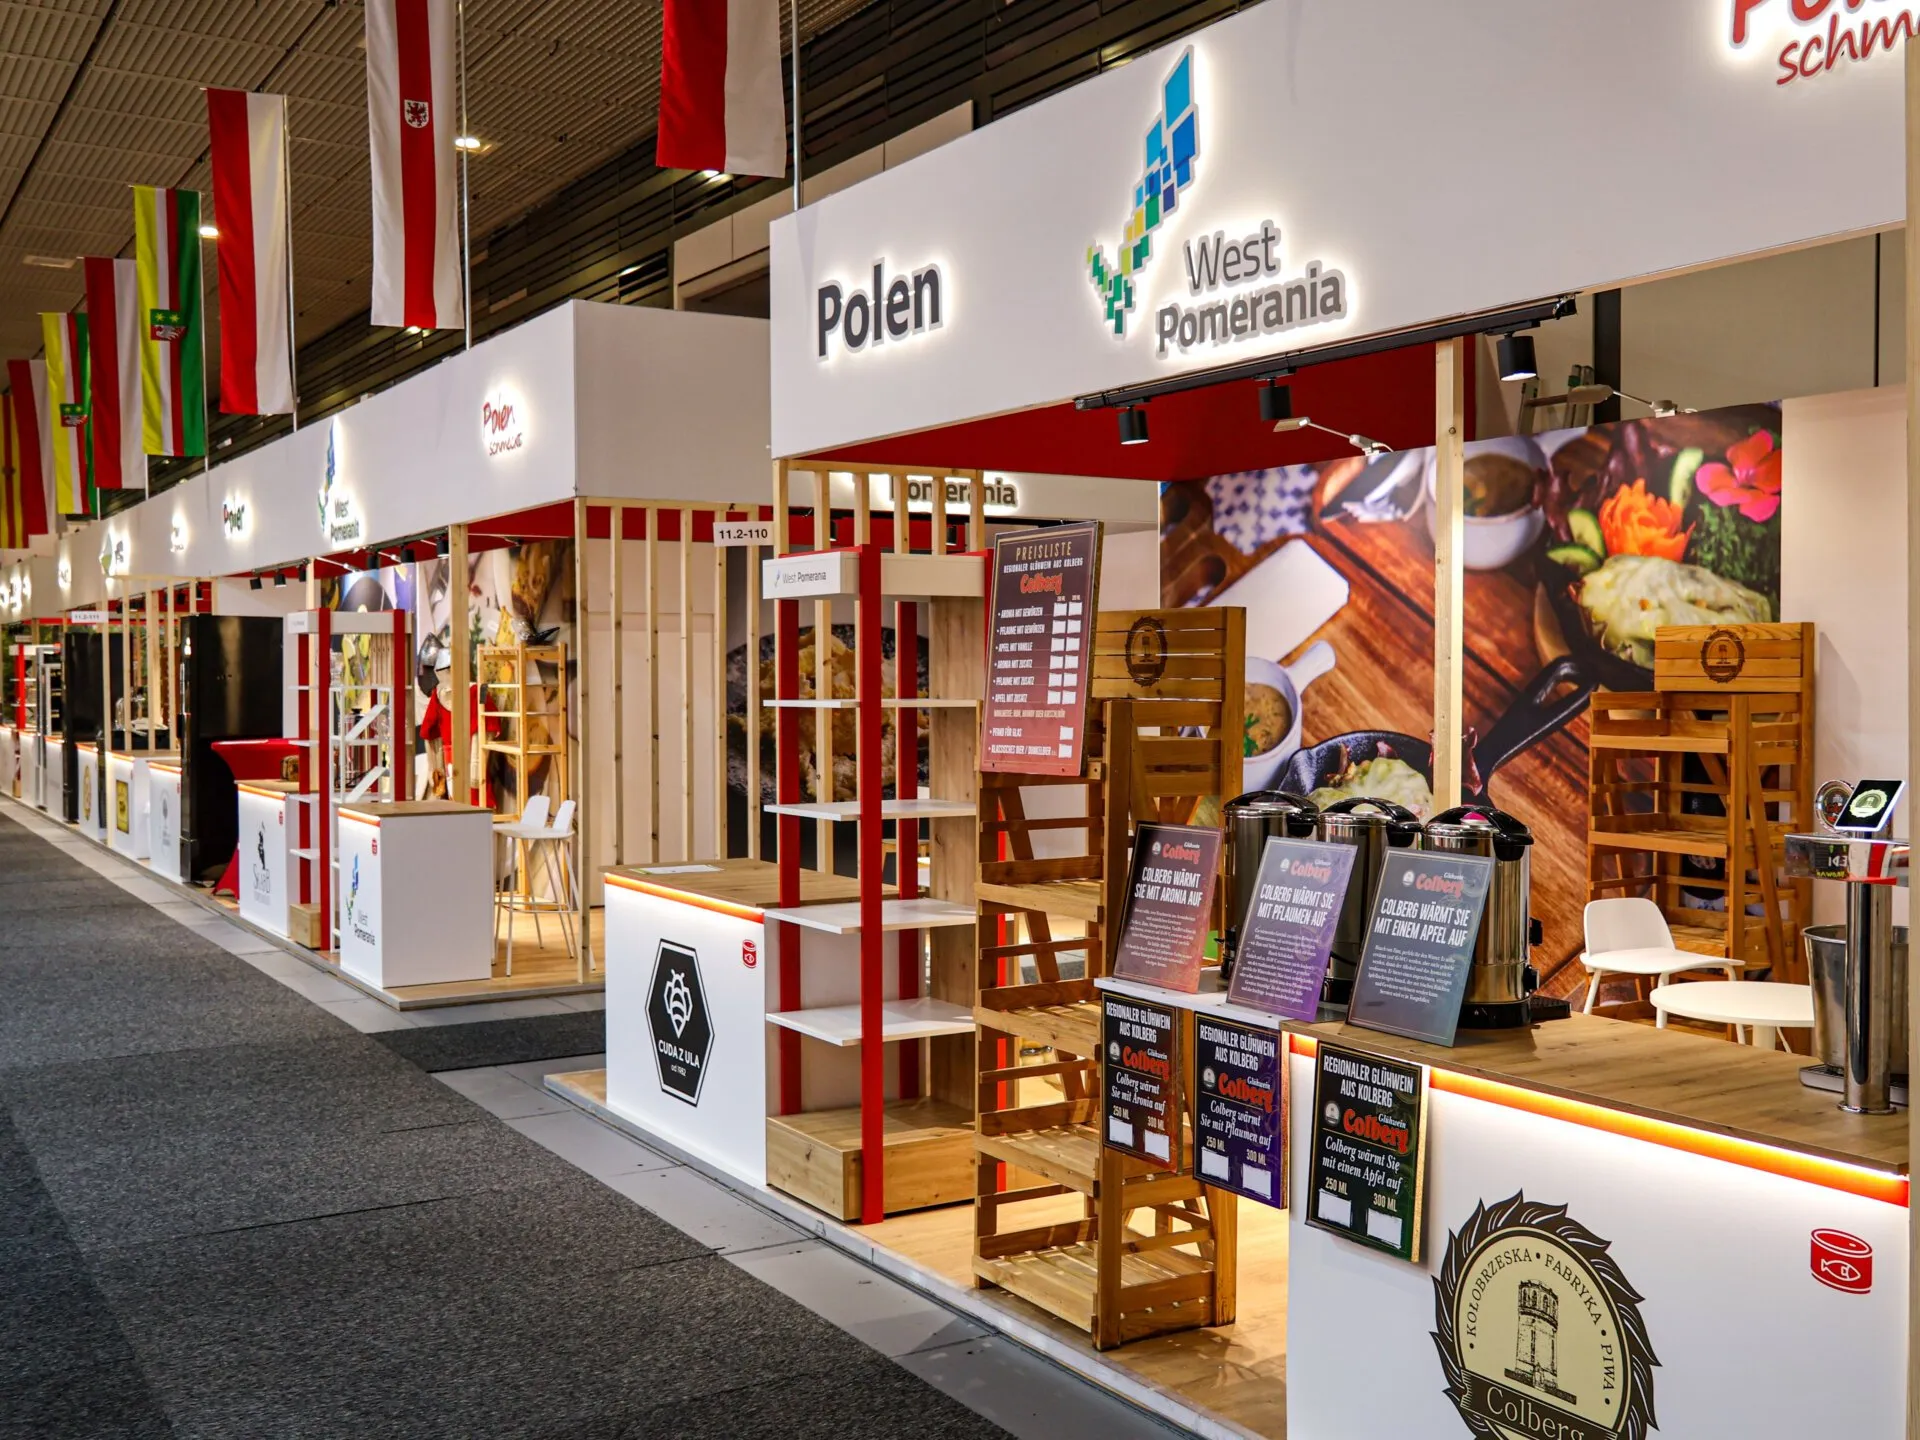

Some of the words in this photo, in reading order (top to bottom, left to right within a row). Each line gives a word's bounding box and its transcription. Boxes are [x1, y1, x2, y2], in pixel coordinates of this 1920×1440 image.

[1776, 10, 1920, 86] schm
[1185, 226, 1277, 290] West
[818, 263, 940, 357] Polen
[1158, 267, 1342, 347] Pomerania
[891, 474, 1016, 506] omernia
[719, 528, 768, 540] 11.2-110
[1016, 541, 1072, 561] PREISLISTE
[782, 572, 796, 584] West
[797, 571, 827, 582] Pomerania
[1161, 843, 1200, 865] Colberg
[1142, 866, 1172, 885] COLBERG
[1173, 868, 1201, 889] WÄRMT
[1290, 860, 1332, 883] Colberg
[1134, 883, 1145, 898] SIE
[1146, 885, 1160, 900] MIT
[1161, 887, 1187, 906] ARONIA
[1187, 890, 1203, 907] AUF
[1260, 883, 1292, 903] COLBERG
[1292, 885, 1322, 906] WÄRMT
[1321, 892, 1335, 909] SIE
[1415, 873, 1464, 899] Colberg
[1257, 901, 1271, 919] MIT
[1272, 904, 1311, 926] PFLAUMEN
[1311, 910, 1327, 927] AUF
[1380, 897, 1418, 919] COLBERG
[1419, 900, 1455, 925] WÄRMT
[1454, 908, 1471, 927] SIE
[1374, 916, 1391, 935] MIT
[1391, 919, 1420, 940] EINEM
[1420, 924, 1446, 944] APFEL
[1447, 928, 1468, 947] AUF
[1106, 1001, 1140, 1023] REGIONALER
[1140, 1007, 1171, 1030] GLÜHWEIN
[1119, 1021, 1131, 1037] AUS
[1131, 1025, 1157, 1044] KOLBERG
[1200, 1024, 1239, 1048] REGIONALER
[1239, 1031, 1275, 1058] GLÜHWEIN
[658, 1039, 678, 1060] CUDA
[678, 1047, 684, 1061] Z
[684, 1050, 700, 1069] ULA
[1122, 1045, 1170, 1082] Colberg
[1214, 1046, 1228, 1063] AUS
[1228, 1050, 1259, 1072] KOLBERG
[1116, 1071, 1139, 1092] Colberg
[1139, 1081, 1160, 1096] wärmt
[1323, 1054, 1370, 1083] REGIONALER
[1371, 1066, 1414, 1094] GLÜHWEIN
[1111, 1085, 1121, 1099] Sie
[1121, 1088, 1132, 1102] mit
[1132, 1092, 1154, 1109] Aronia
[1154, 1100, 1166, 1116] auf
[1217, 1072, 1275, 1113] Colberg
[1340, 1079, 1356, 1099] AUS
[1357, 1083, 1393, 1108] KOLBERG
[1112, 1105, 1122, 1117] 250
[1122, 1108, 1130, 1120] ML
[1147, 1115, 1157, 1128] 300
[1157, 1119, 1165, 1131] ML
[1210, 1100, 1237, 1123] Colberg
[1237, 1110, 1261, 1127] wärmt
[1378, 1113, 1407, 1129] Glühwein
[1200, 1113, 1211, 1127] Sie
[1212, 1117, 1224, 1132] mit
[1224, 1120, 1258, 1143] Pflaumen
[1258, 1134, 1273, 1151] auf
[1206, 1135, 1217, 1149] 250
[1217, 1139, 1225, 1152] ML
[1343, 1108, 1409, 1154] Colberg
[1246, 1149, 1256, 1163] 300
[1256, 1152, 1266, 1166] ML
[1325, 1135, 1357, 1161] Colberg
[1357, 1147, 1386, 1168] wärmt
[1322, 1154, 1336, 1170] mit
[1337, 1160, 1361, 1178] einem
[1362, 1167, 1385, 1189] Apfel
[1386, 1177, 1403, 1196] auf
[1325, 1176, 1338, 1192] 250
[1338, 1181, 1348, 1196] ML
[1373, 1192, 1386, 1208] 300
[1387, 1197, 1397, 1212] ML
[1544, 1253, 1602, 1326] FABRYKA
[1600, 1343, 1615, 1391] PIWA
